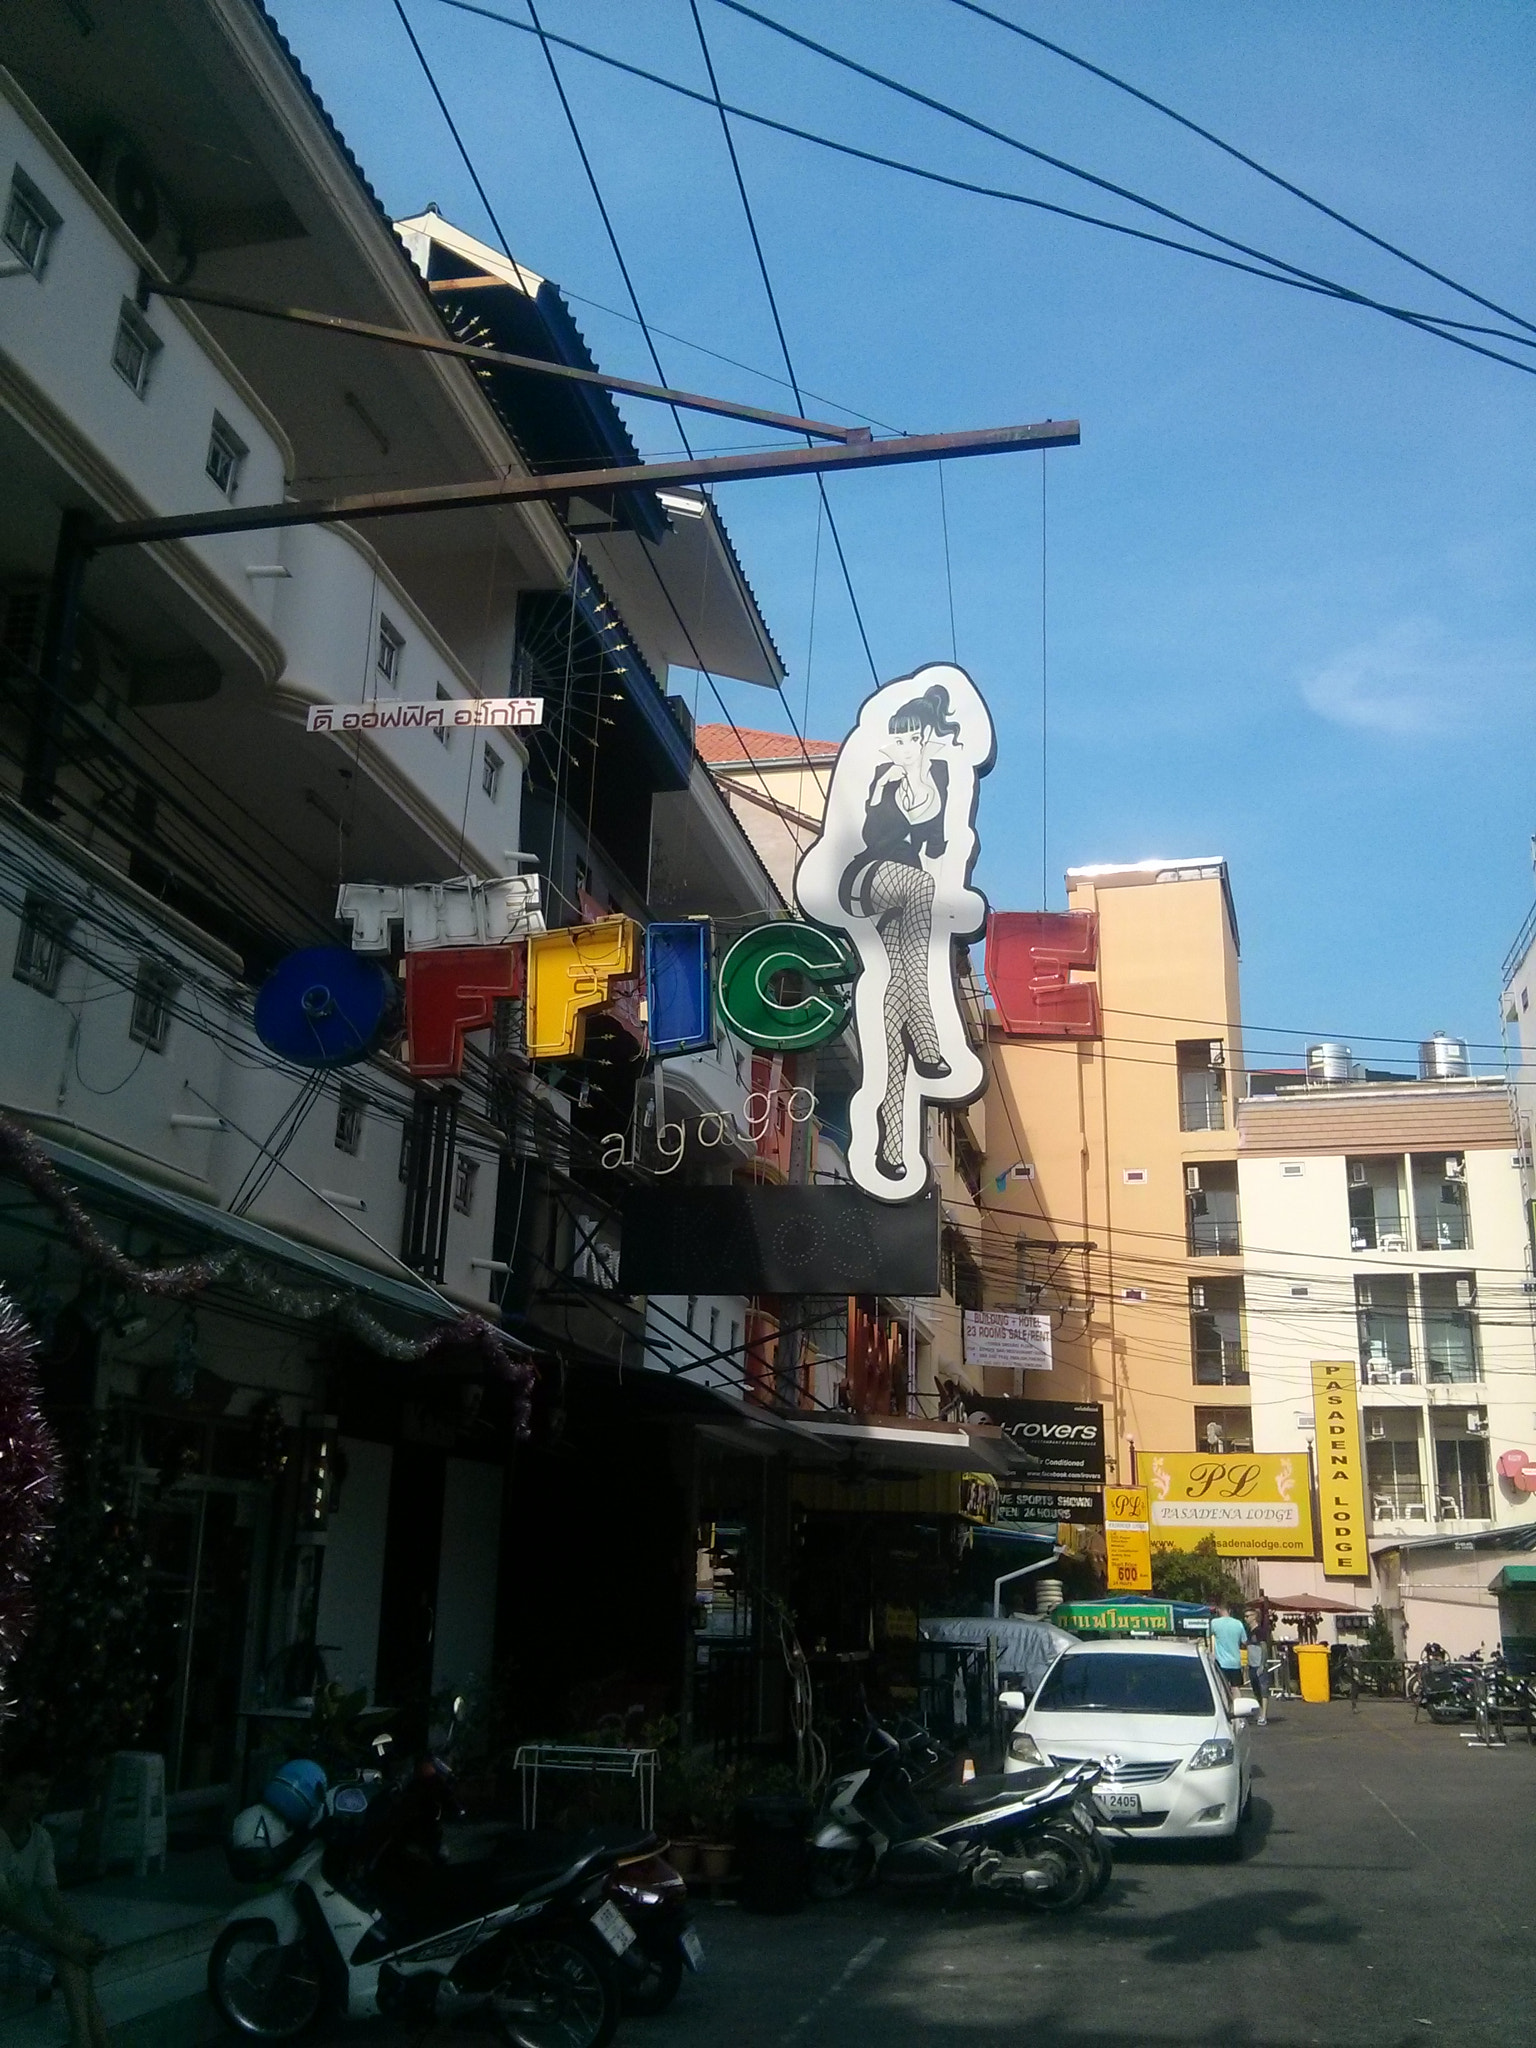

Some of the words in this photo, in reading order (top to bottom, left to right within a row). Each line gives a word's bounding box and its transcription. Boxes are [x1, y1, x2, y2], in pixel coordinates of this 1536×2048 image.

[342, 705, 445, 729] ออฟฟิศ
[454, 700, 537, 726] อะโกโก้
[335, 873, 547, 954] THE
[974, 1312, 1009, 1326] BUILDING
[1018, 1316, 1041, 1328] HOTEL
[966, 1326, 977, 1337] 23
[979, 1327, 1007, 1339] ROOMS
[1009, 1329, 1050, 1342] SALE/RENT
[1326, 1366, 1349, 1480] PASADENA
[1000, 1494, 1013, 1504] VE
[1016, 1494, 1054, 1506] SPORTS
[1000, 1507, 1018, 1517] PEN
[1024, 1507, 1036, 1518] 24
[1037, 1508, 1072, 1519] HOURS
[1161, 1508, 1242, 1520] PASADENA
[1246, 1508, 1294, 1523] LODGE
[1333, 1496, 1353, 1568] LODGE
[1118, 1567, 1138, 1582] 600
[1057, 1608, 1168, 1629] กาแฟโบราณ
[1110, 1795, 1137, 1808] 2405
